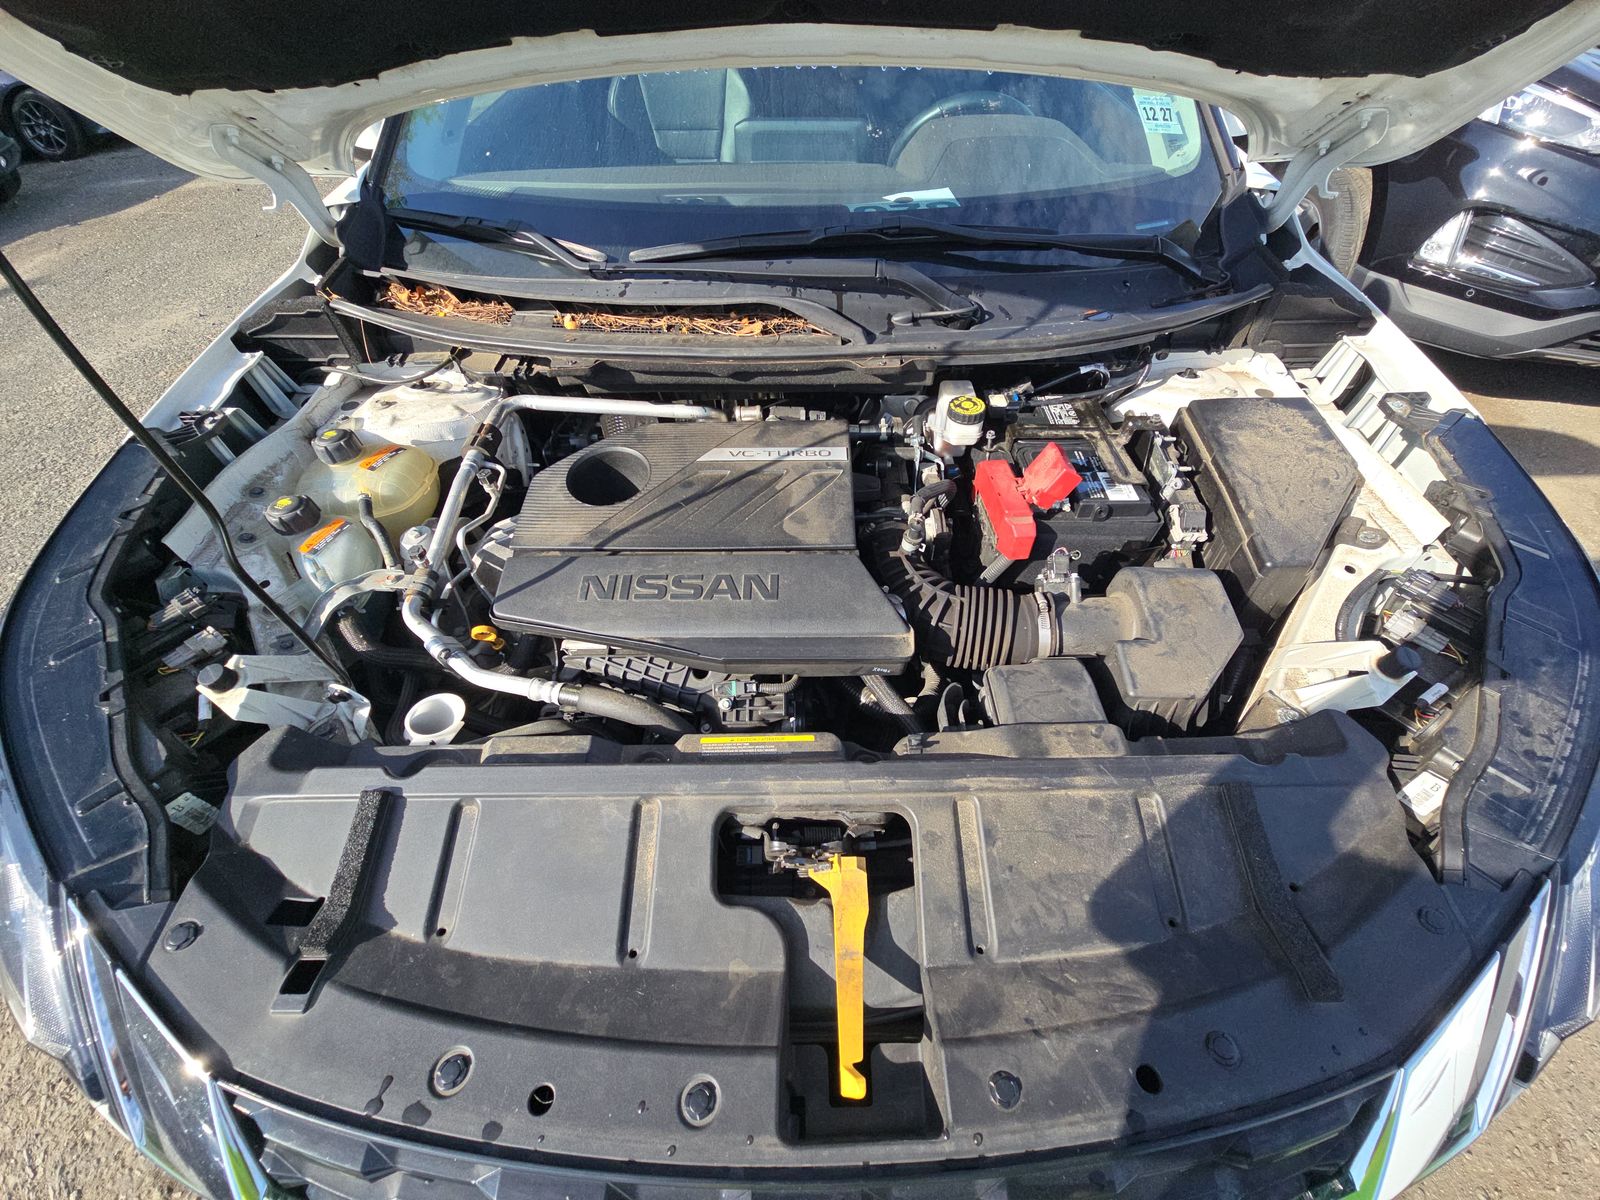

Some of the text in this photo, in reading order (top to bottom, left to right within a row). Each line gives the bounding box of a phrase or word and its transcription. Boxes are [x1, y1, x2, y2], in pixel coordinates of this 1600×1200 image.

[1142, 106, 1173, 122] 12 27
[728, 449, 832, 458] VC-TURBO
[577, 573, 780, 601] NISSAN
